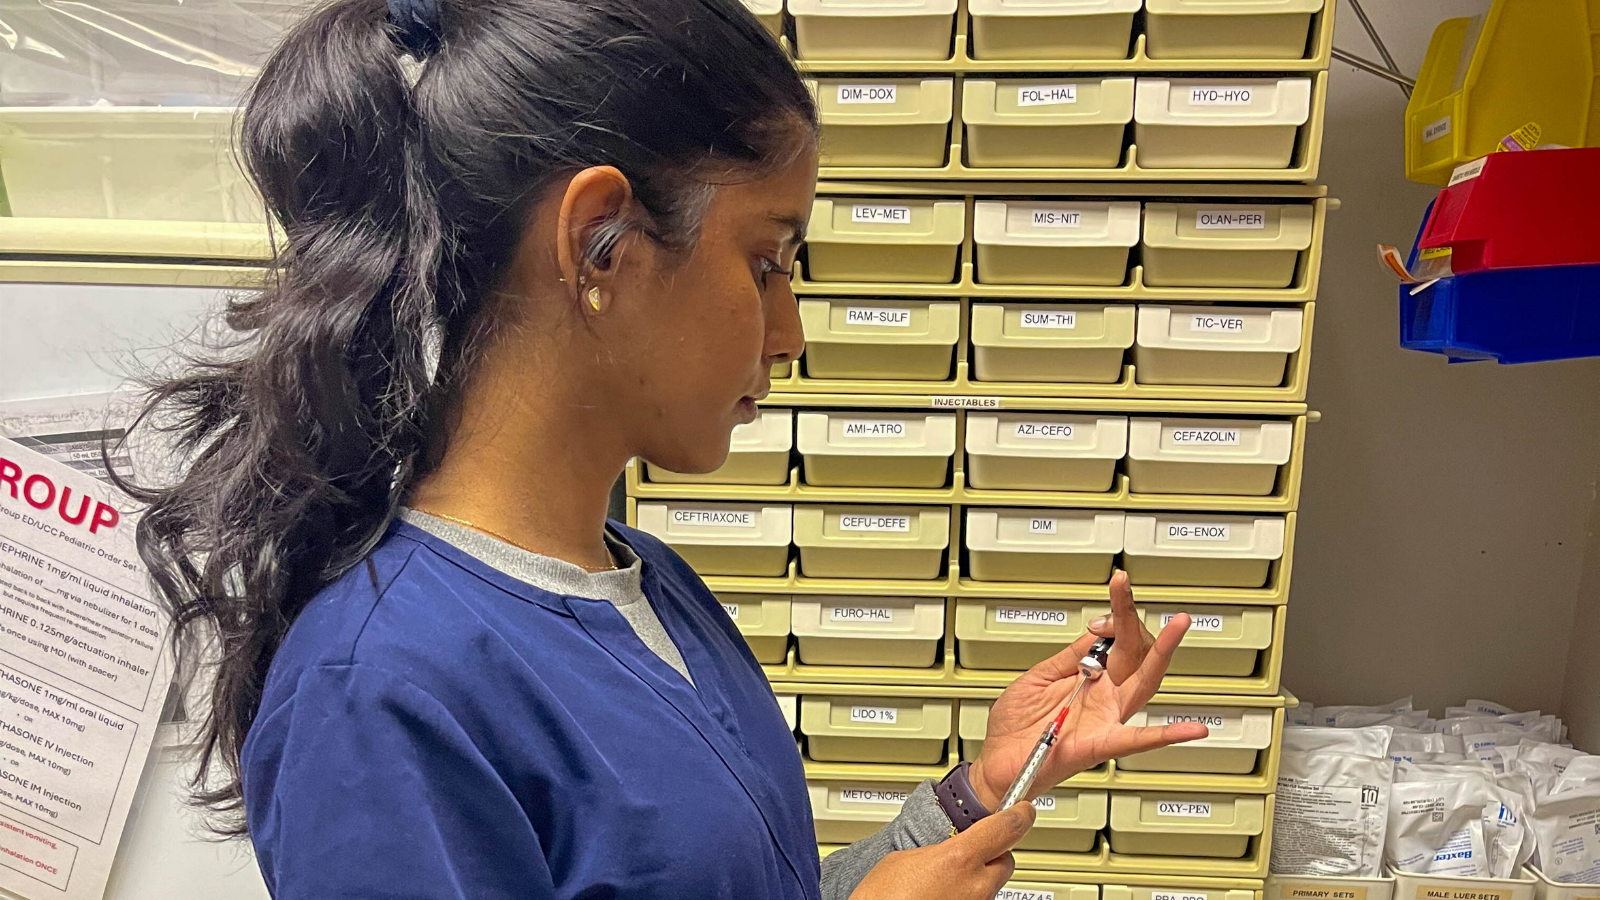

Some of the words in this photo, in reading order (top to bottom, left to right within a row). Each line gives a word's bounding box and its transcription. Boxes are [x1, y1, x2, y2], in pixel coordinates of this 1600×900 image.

[841, 88, 894, 100] DIM-DOX
[1022, 88, 1075, 102] FOL-HAL
[1192, 90, 1250, 102] HYD-HYO
[855, 207, 907, 220] LEV-MET
[1033, 212, 1080, 224] MIS-NIT
[1200, 214, 1262, 226] OLAN-PER
[848, 310, 908, 323] RAM-SULF
[1024, 313, 1074, 325] SUM-THI
[1195, 317, 1243, 330] TIC-VER
[933, 398, 996, 407] INJECTABLES
[846, 423, 903, 435] AMI-ATRO
[1017, 424, 1072, 436] AZI-CEFO
[1173, 431, 1236, 442] CEFAZOLIN
[674, 511, 750, 524] CEFTRIAXONE
[842, 516, 906, 529] CEFU-DEFE
[1031, 519, 1053, 530] DIM
[0, 503, 21, 520] roup
[21, 514, 58, 536] ED/UCC
[58, 530, 96, 555] Pediatric
[97, 548, 122, 565] Order
[122, 559, 138, 572] Set
[1168, 526, 1225, 538] DIG-ENOX
[0, 541, 45, 569] EPHRINE
[47, 562, 82, 586] 1mg/ml
[83, 578, 110, 598] liquid
[110, 590, 157, 619] inhalation
[0, 561, 34, 582] halation
[70, 593, 82, 604] via
[83, 599, 120, 621] nebulizer
[120, 615, 132, 626] for
[139, 623, 159, 638] dose
[834, 607, 891, 620] FURO-HAL
[999, 609, 1066, 622] HEP-HYDRO
[30, 618, 116, 664] 0.125mg/actuation
[117, 655, 150, 677] inhaler
[6, 626, 26, 640] once
[27, 636, 49, 653] using
[50, 646, 67, 660] MDI
[67, 652, 87, 668] (with
[87, 661, 118, 683] spacer)
[45, 689, 78, 711] 1mg/ml
[79, 706, 97, 720] oral
[98, 713, 124, 731] liquid
[852, 708, 877, 719] LIDO
[879, 710, 894, 721] 1%
[42, 706, 60, 721] MAX
[61, 715, 86, 733] 10mg)
[1166, 715, 1222, 726] LIDO-MAG
[44, 739, 55, 750] IV
[55, 743, 94, 768] Injection
[28, 751, 46, 765] MAX
[48, 759, 71, 777] 10mg)
[30, 782, 42, 794] IM
[43, 787, 82, 812] Injection
[15, 794, 34, 808] MAX
[34, 802, 59, 819] 10mg)
[1158, 802, 1210, 815] OXY-PEN
[1434, 850, 1473, 862] Baxter
[35, 859, 58, 875] ONCE
[1292, 889, 1329, 898] PRIMARY
[1332, 889, 1355, 899] SETS
[1427, 890, 1450, 899] MALE
[1453, 891, 1477, 900] LUER
[1477, 892, 1500, 900] SETS
